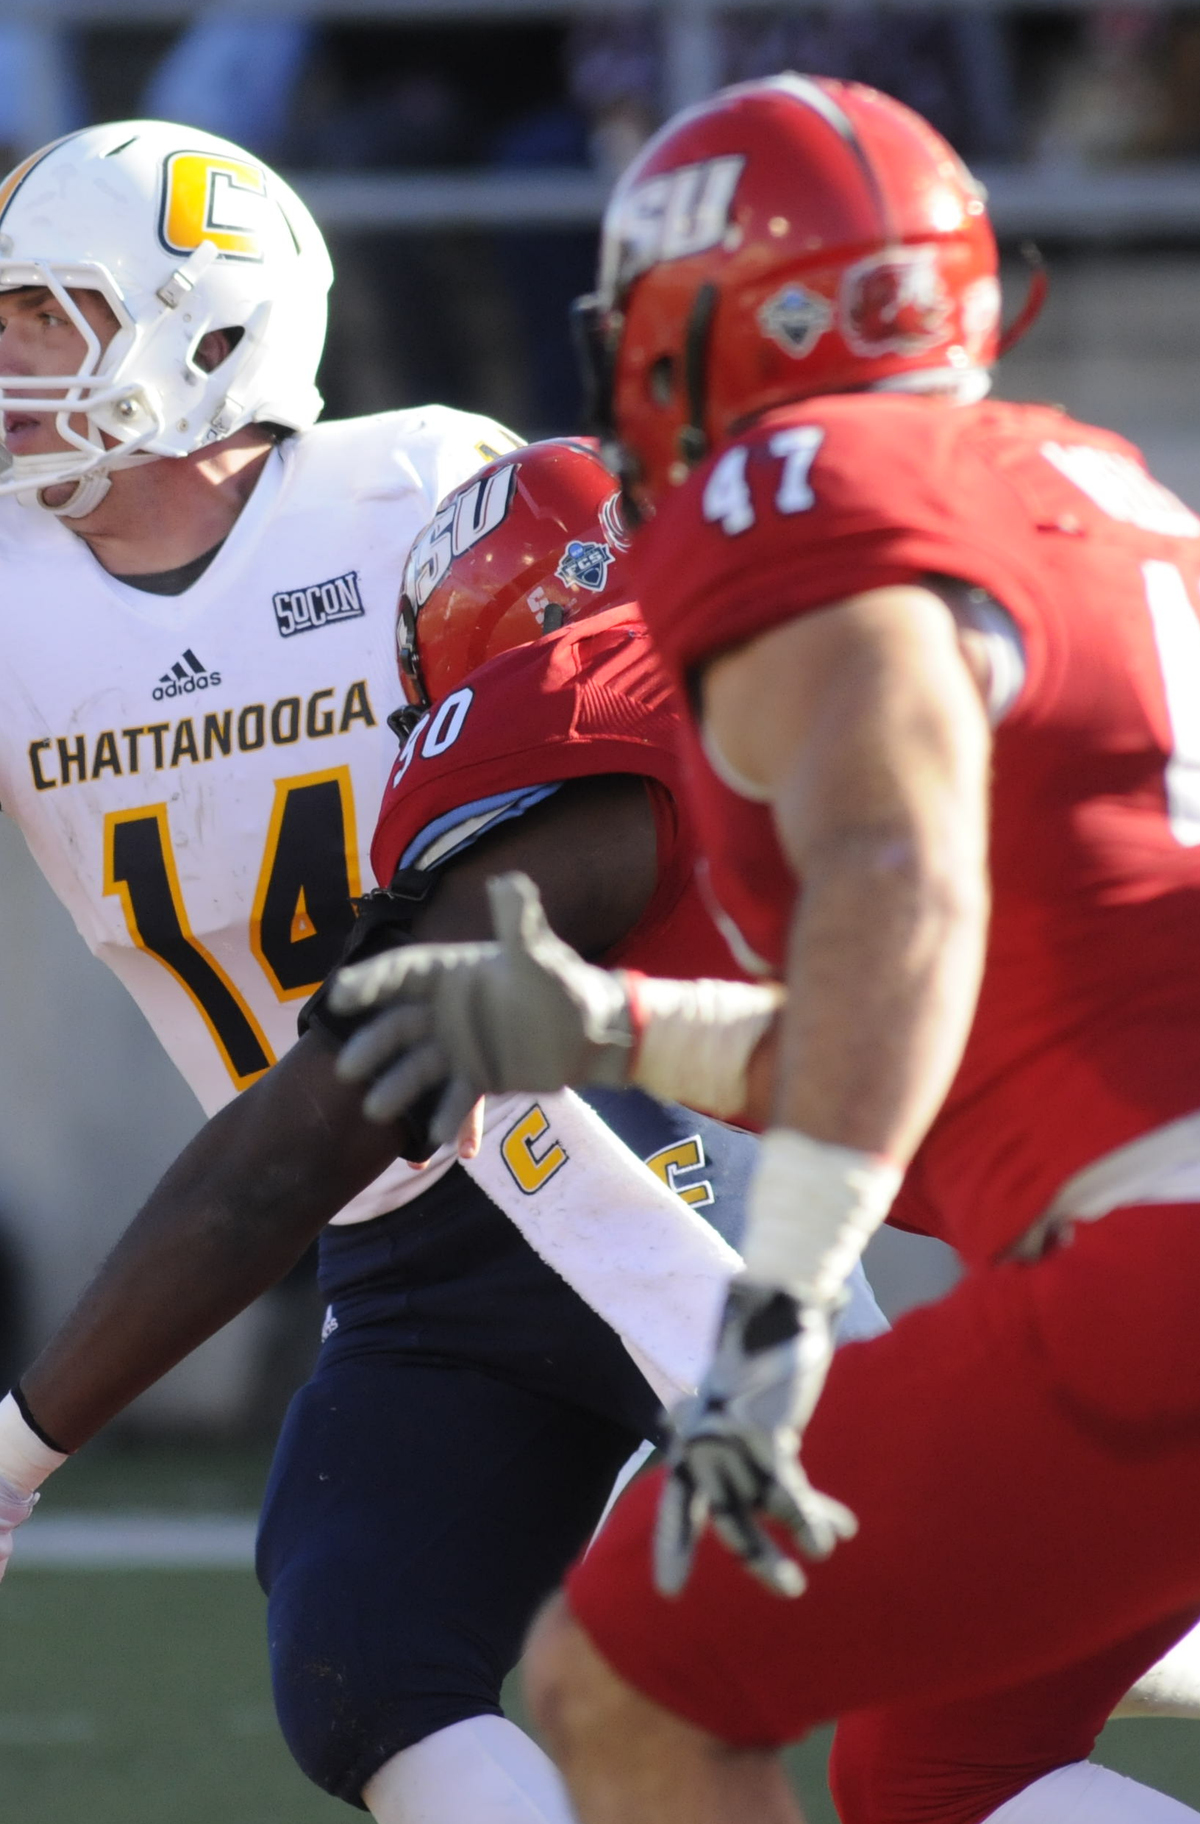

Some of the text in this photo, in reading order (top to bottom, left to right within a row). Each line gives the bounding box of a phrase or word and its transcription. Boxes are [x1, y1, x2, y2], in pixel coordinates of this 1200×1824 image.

[703, 424, 825, 536] 47
[565, 551, 602, 577] FCS
[152, 671, 222, 701] adidas
[28, 679, 377, 791] CHATTANOOGA
[103, 764, 362, 1092] 14
[501, 1103, 569, 1194] C
[643, 1134, 715, 1209] C
